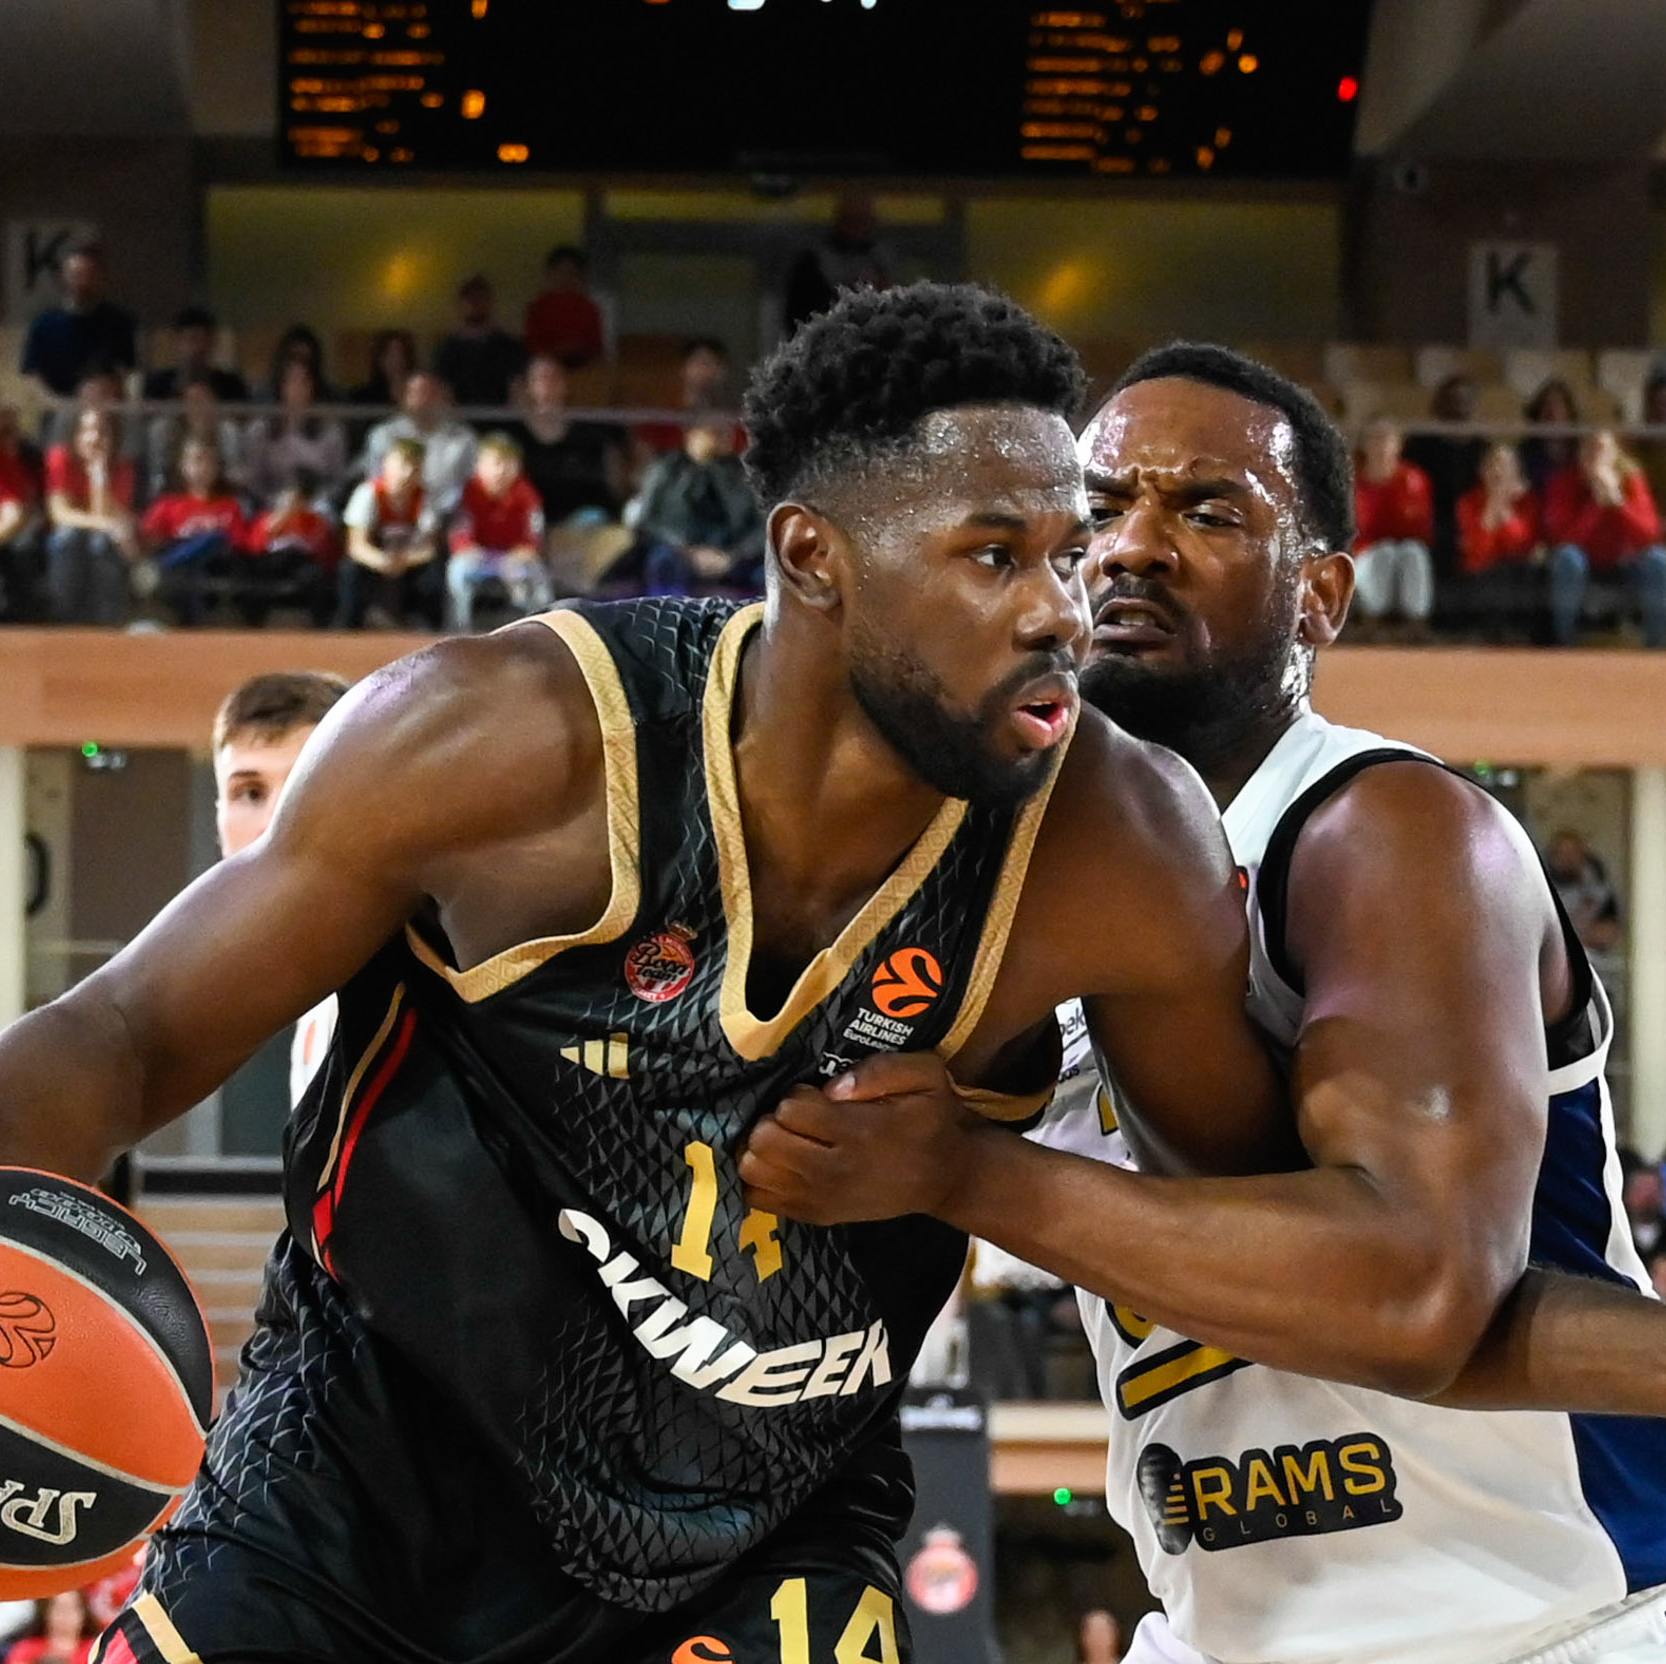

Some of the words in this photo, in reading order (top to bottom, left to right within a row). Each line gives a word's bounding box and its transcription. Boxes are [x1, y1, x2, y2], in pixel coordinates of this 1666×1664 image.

[1487, 251, 1536, 314] K
[848, 1019, 908, 1046] AIRLINES
[857, 1007, 915, 1037] TURKISH
[8, 1192, 148, 1276] LEGACY
[1191, 1443, 1387, 1521] RAMS
[1202, 1499, 1393, 1544] GLOBAL
